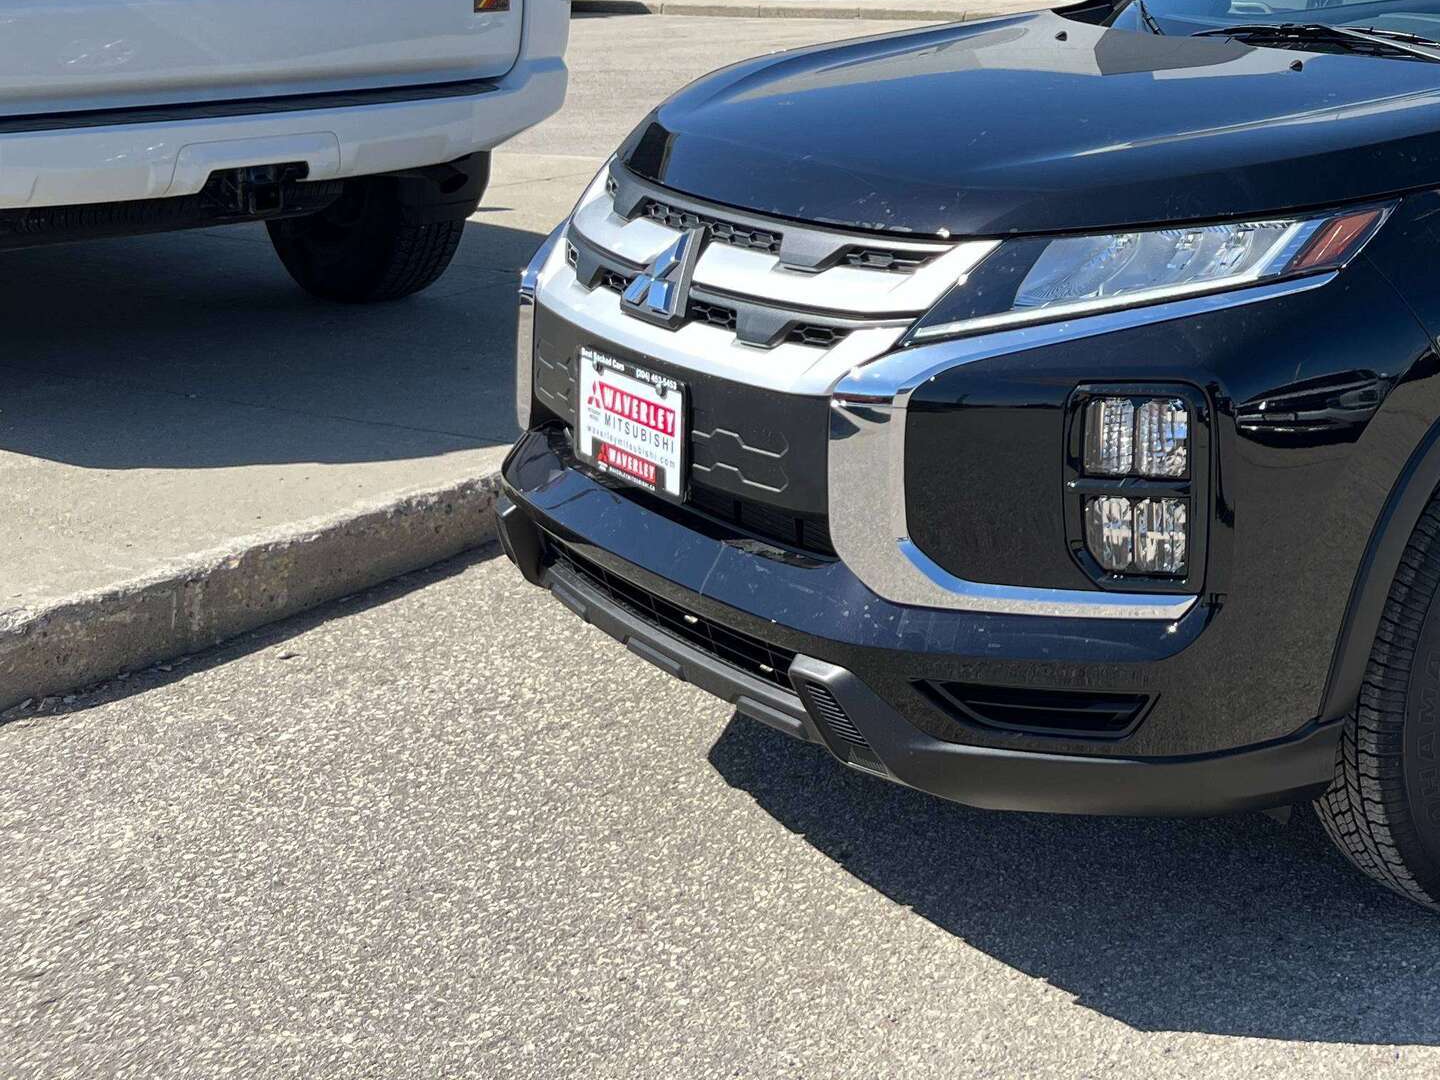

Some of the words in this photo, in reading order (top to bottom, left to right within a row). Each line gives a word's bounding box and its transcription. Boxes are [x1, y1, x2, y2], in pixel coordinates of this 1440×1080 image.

[602, 386, 675, 436] WAVERLEY
[604, 413, 675, 454] MITSUBISHI
[608, 448, 656, 480] WAVERLEY
